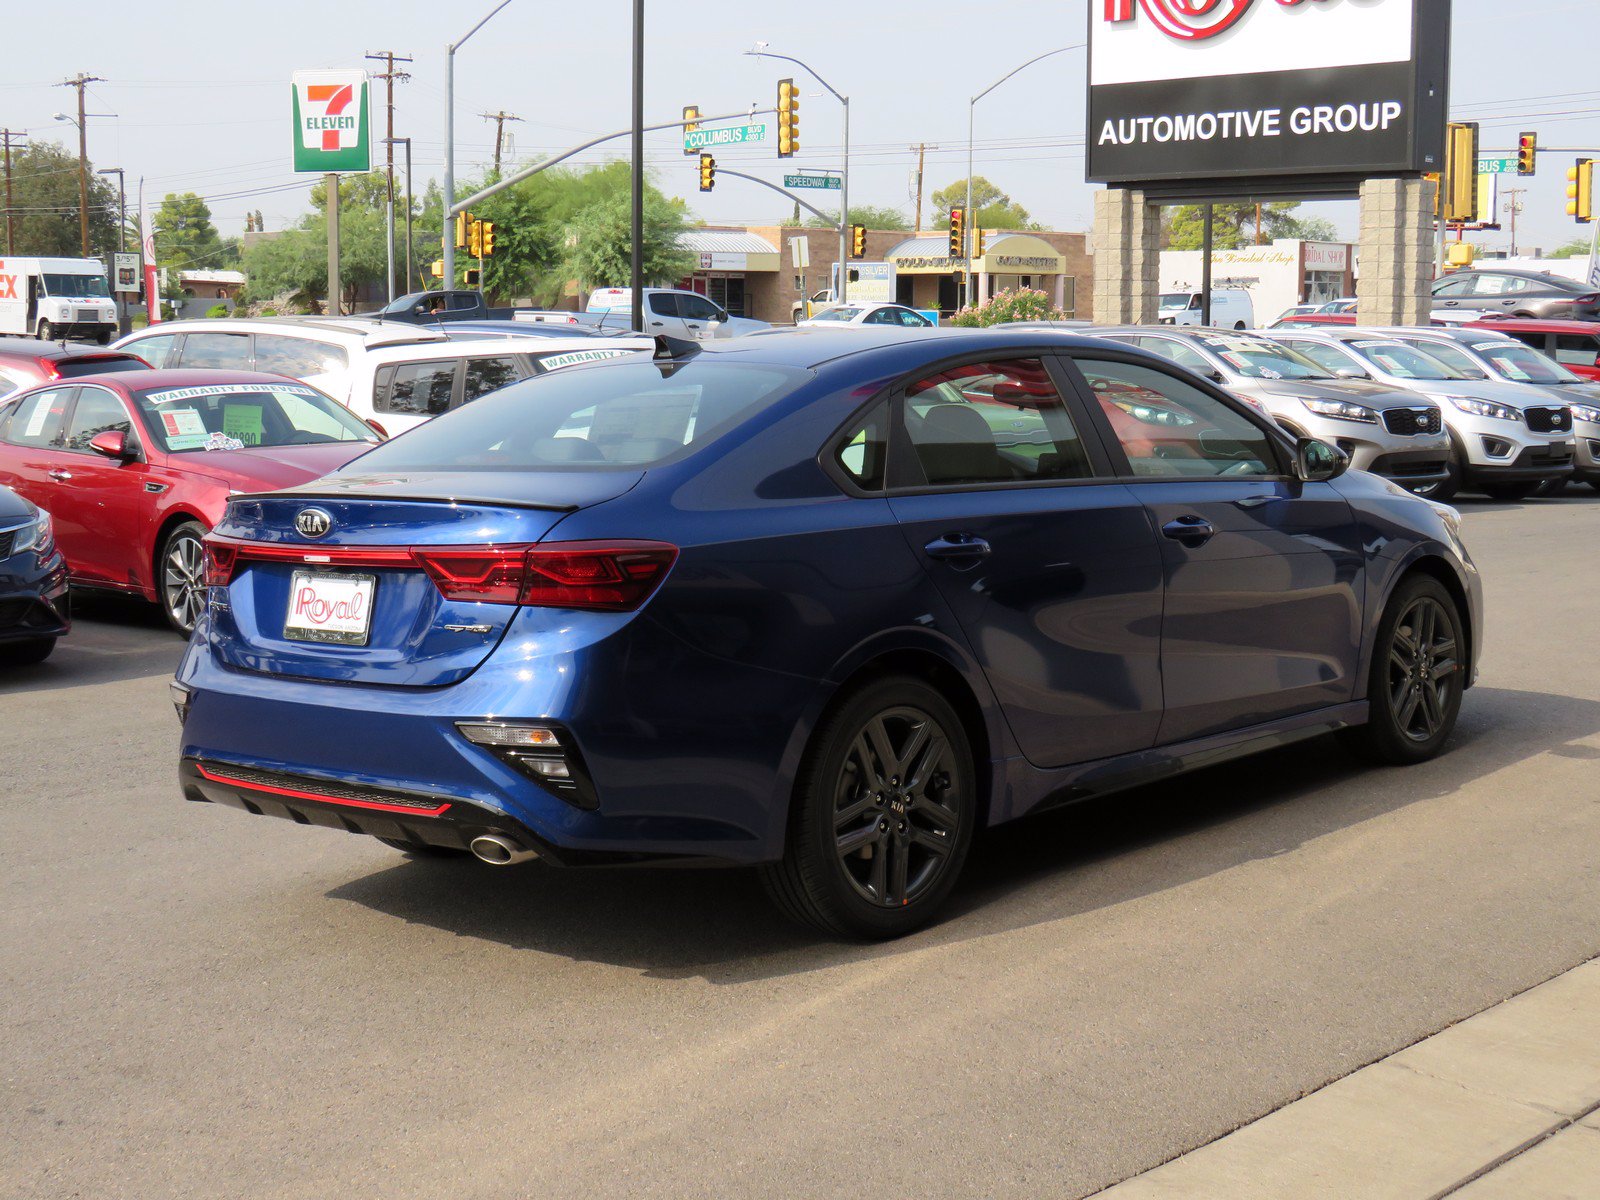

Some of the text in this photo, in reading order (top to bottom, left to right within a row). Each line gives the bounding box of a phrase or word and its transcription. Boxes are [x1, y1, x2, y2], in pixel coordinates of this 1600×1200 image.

[307, 83, 353, 151] 7
[1097, 101, 1402, 146] AUTOMOTIVE GROUP
[689, 128, 743, 147] COLUMBUS
[747, 125, 762, 134] BLVD
[745, 132, 759, 142] 4300
[788, 176, 826, 188] SPEEDWAY
[896, 257, 927, 268] GOLD
[1224, 252, 1266, 263] Bridal
[1266, 252, 1295, 266] Shop
[1327, 250, 1345, 263] SHOP
[545, 350, 615, 368] WARRANTY
[153, 385, 236, 402] WARRANTY
[297, 515, 323, 533] KIA
[295, 587, 364, 625] Royal
[327, 623, 362, 632] TUCSON ARIZONA
[890, 800, 905, 814] KIA
